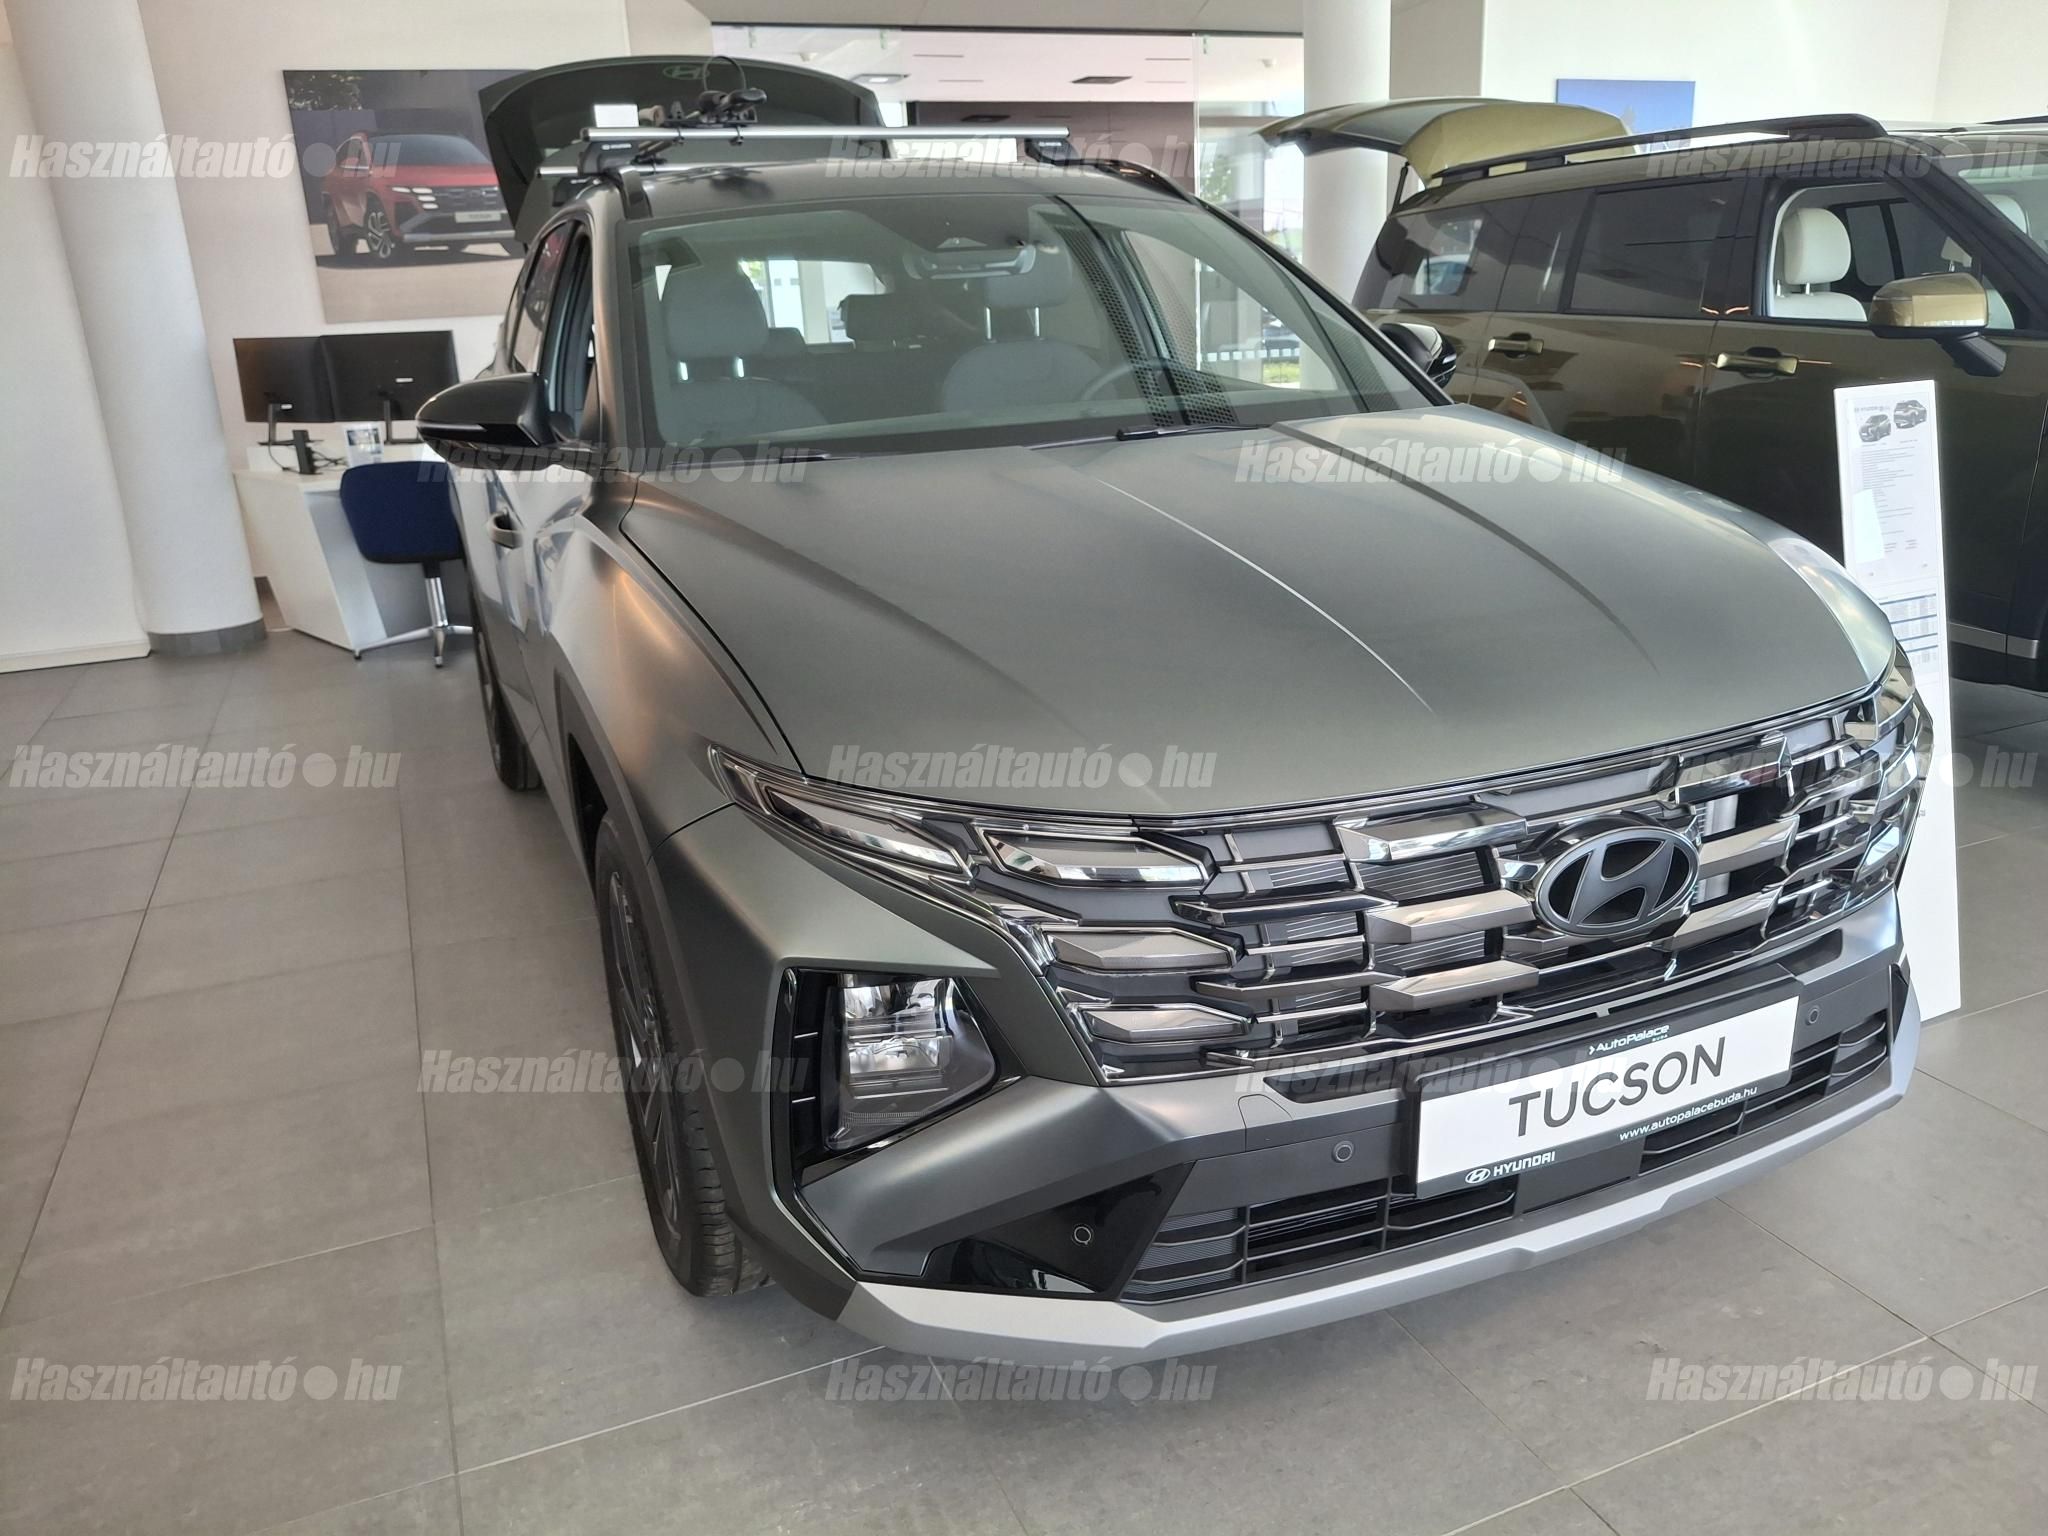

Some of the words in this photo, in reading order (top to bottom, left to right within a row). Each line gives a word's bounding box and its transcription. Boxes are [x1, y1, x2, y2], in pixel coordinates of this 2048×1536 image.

[1596, 1024, 1670, 1051] AutoPalace
[1508, 1036, 1727, 1138] TUCSON
[1619, 1086, 1758, 1142] www.autopalacebuda.hu
[1492, 1150, 1556, 1177] HYUNDAI
